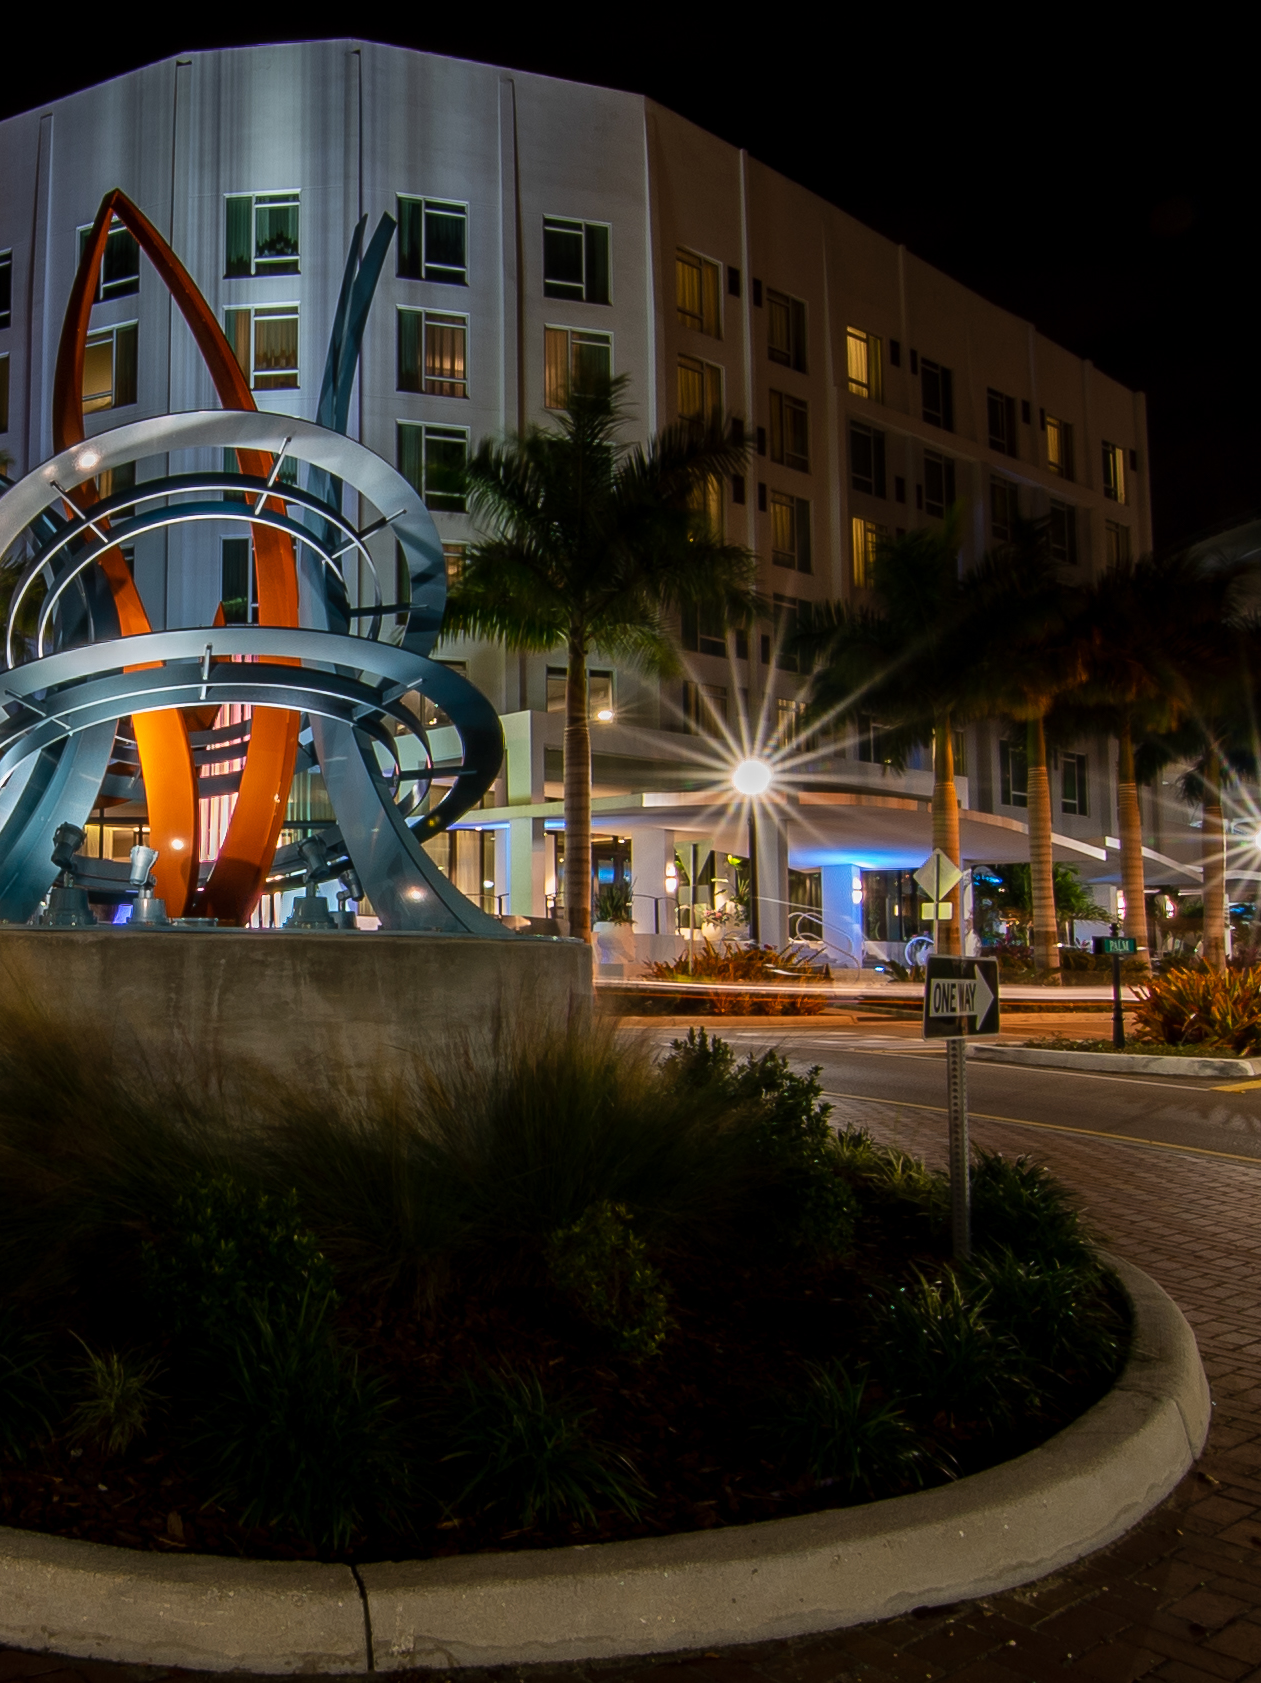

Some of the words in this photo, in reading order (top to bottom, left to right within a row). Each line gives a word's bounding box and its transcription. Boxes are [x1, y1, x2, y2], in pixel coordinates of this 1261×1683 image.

[1109, 938, 1130, 952] PALM
[933, 982, 957, 1014] ONE
[957, 982, 977, 1013] WAY
